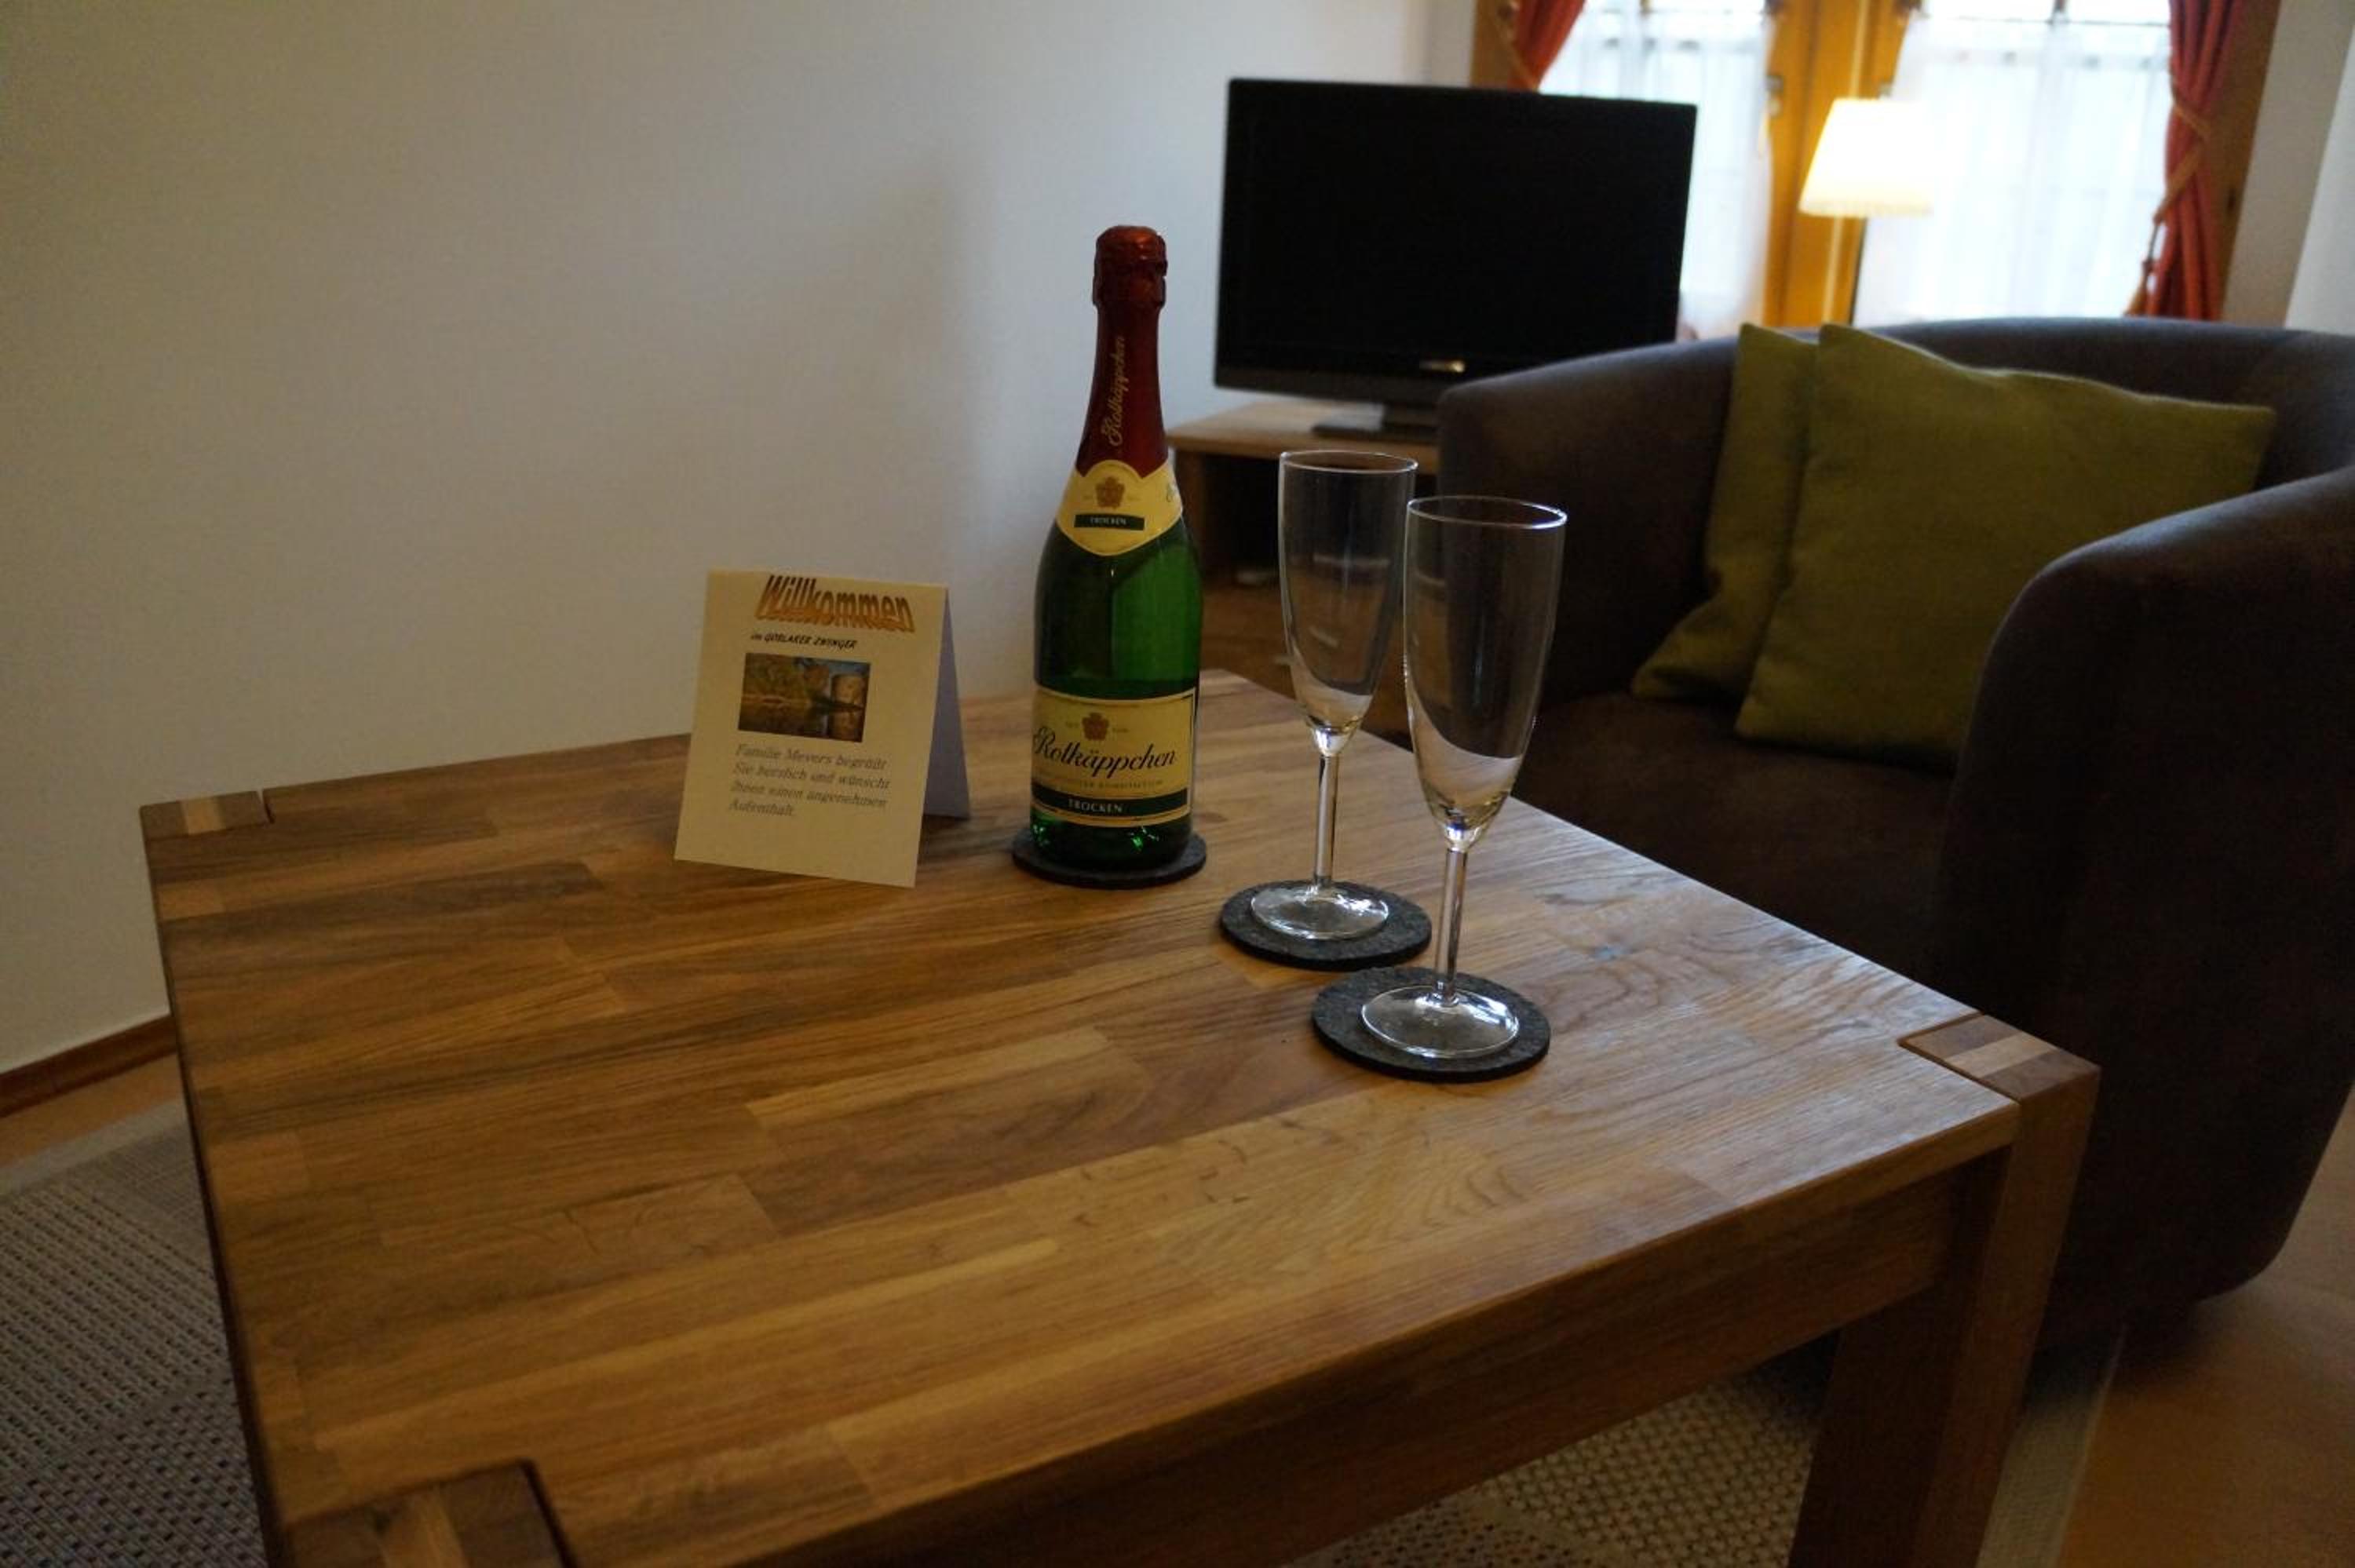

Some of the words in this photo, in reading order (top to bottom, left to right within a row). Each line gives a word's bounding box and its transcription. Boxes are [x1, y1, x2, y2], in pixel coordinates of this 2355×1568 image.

[754, 575, 915, 633] Willkommen
[1033, 726, 1175, 779] Rotkäppchen
[810, 768, 836, 784] und
[1068, 797, 1123, 813] TROCKEN
